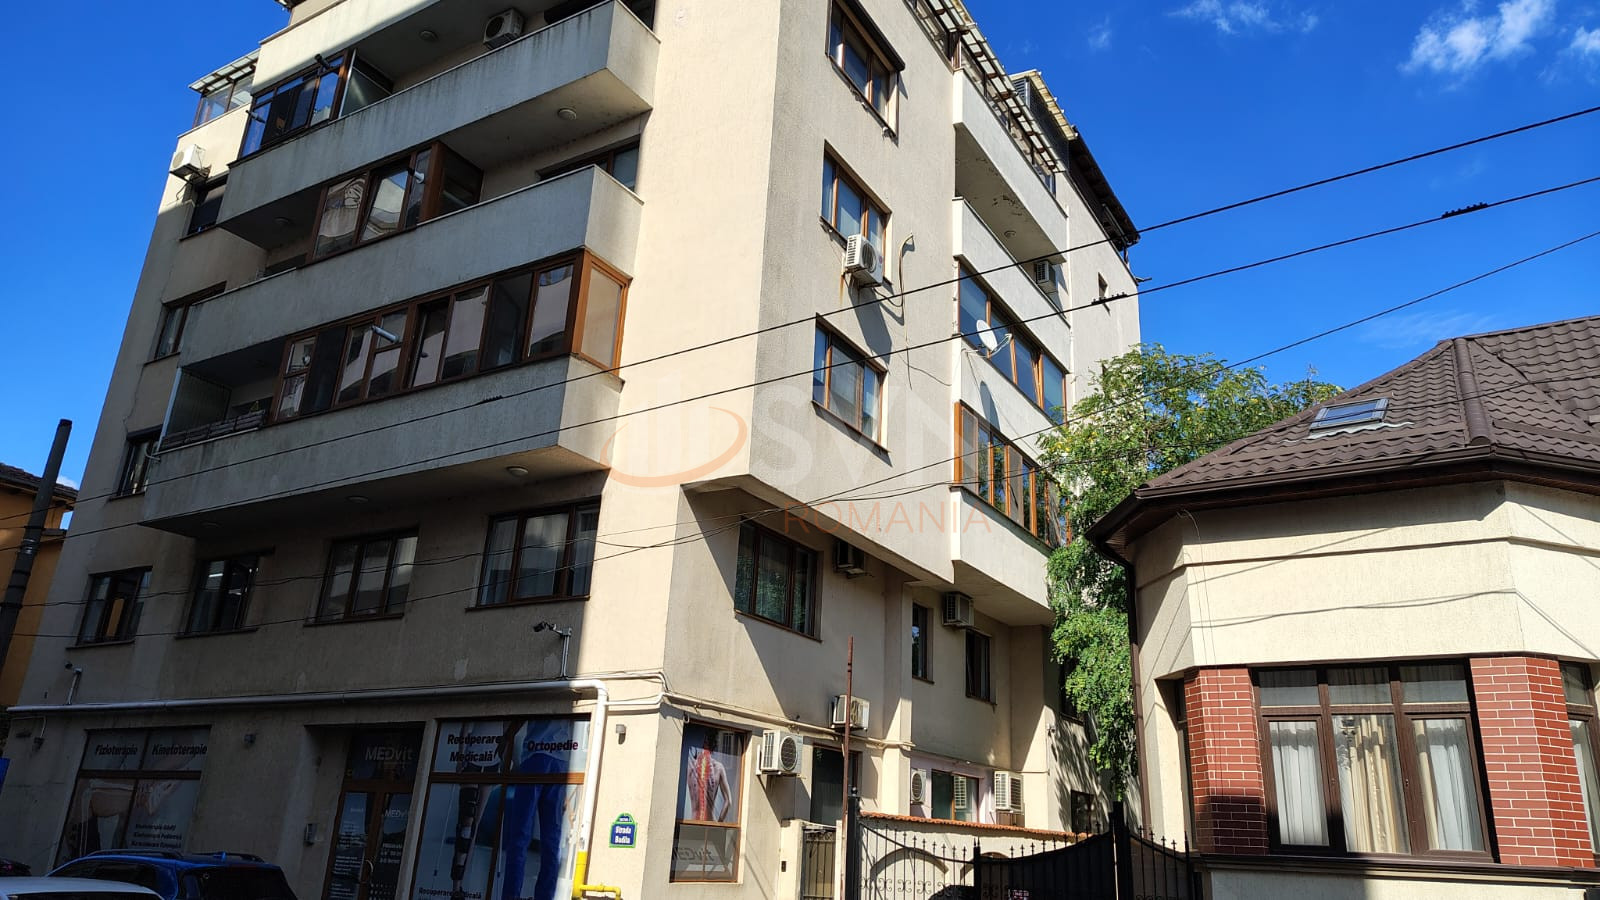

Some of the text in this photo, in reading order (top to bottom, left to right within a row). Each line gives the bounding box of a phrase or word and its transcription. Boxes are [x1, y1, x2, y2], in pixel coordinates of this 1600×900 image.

[447, 733, 501, 747] Recuperare
[527, 739, 579, 753] Ortopedie
[95, 744, 138, 757] Fizioterapie
[152, 744, 208, 757] Kinetoterapie
[449, 751, 494, 763] Medicală
[615, 825, 632, 834] Strada
